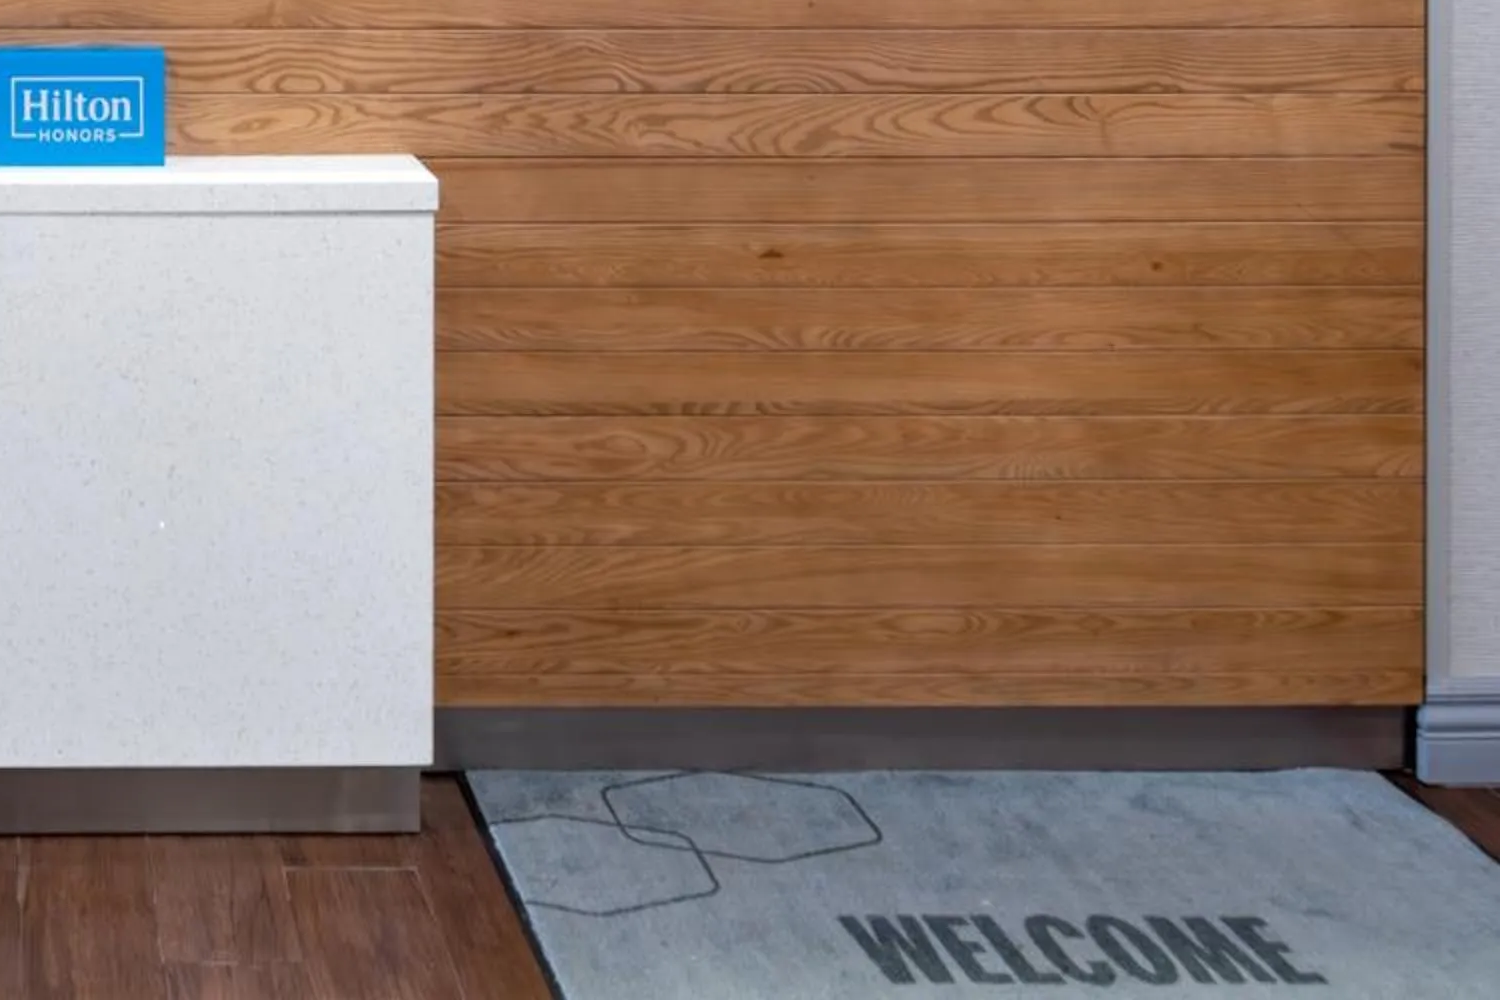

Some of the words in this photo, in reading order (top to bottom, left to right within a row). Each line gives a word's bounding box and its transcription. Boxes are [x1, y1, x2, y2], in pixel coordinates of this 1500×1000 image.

[22, 88, 132, 122] Hilton
[38, 128, 117, 143] HONORS
[838, 914, 1329, 987] WELCOME
